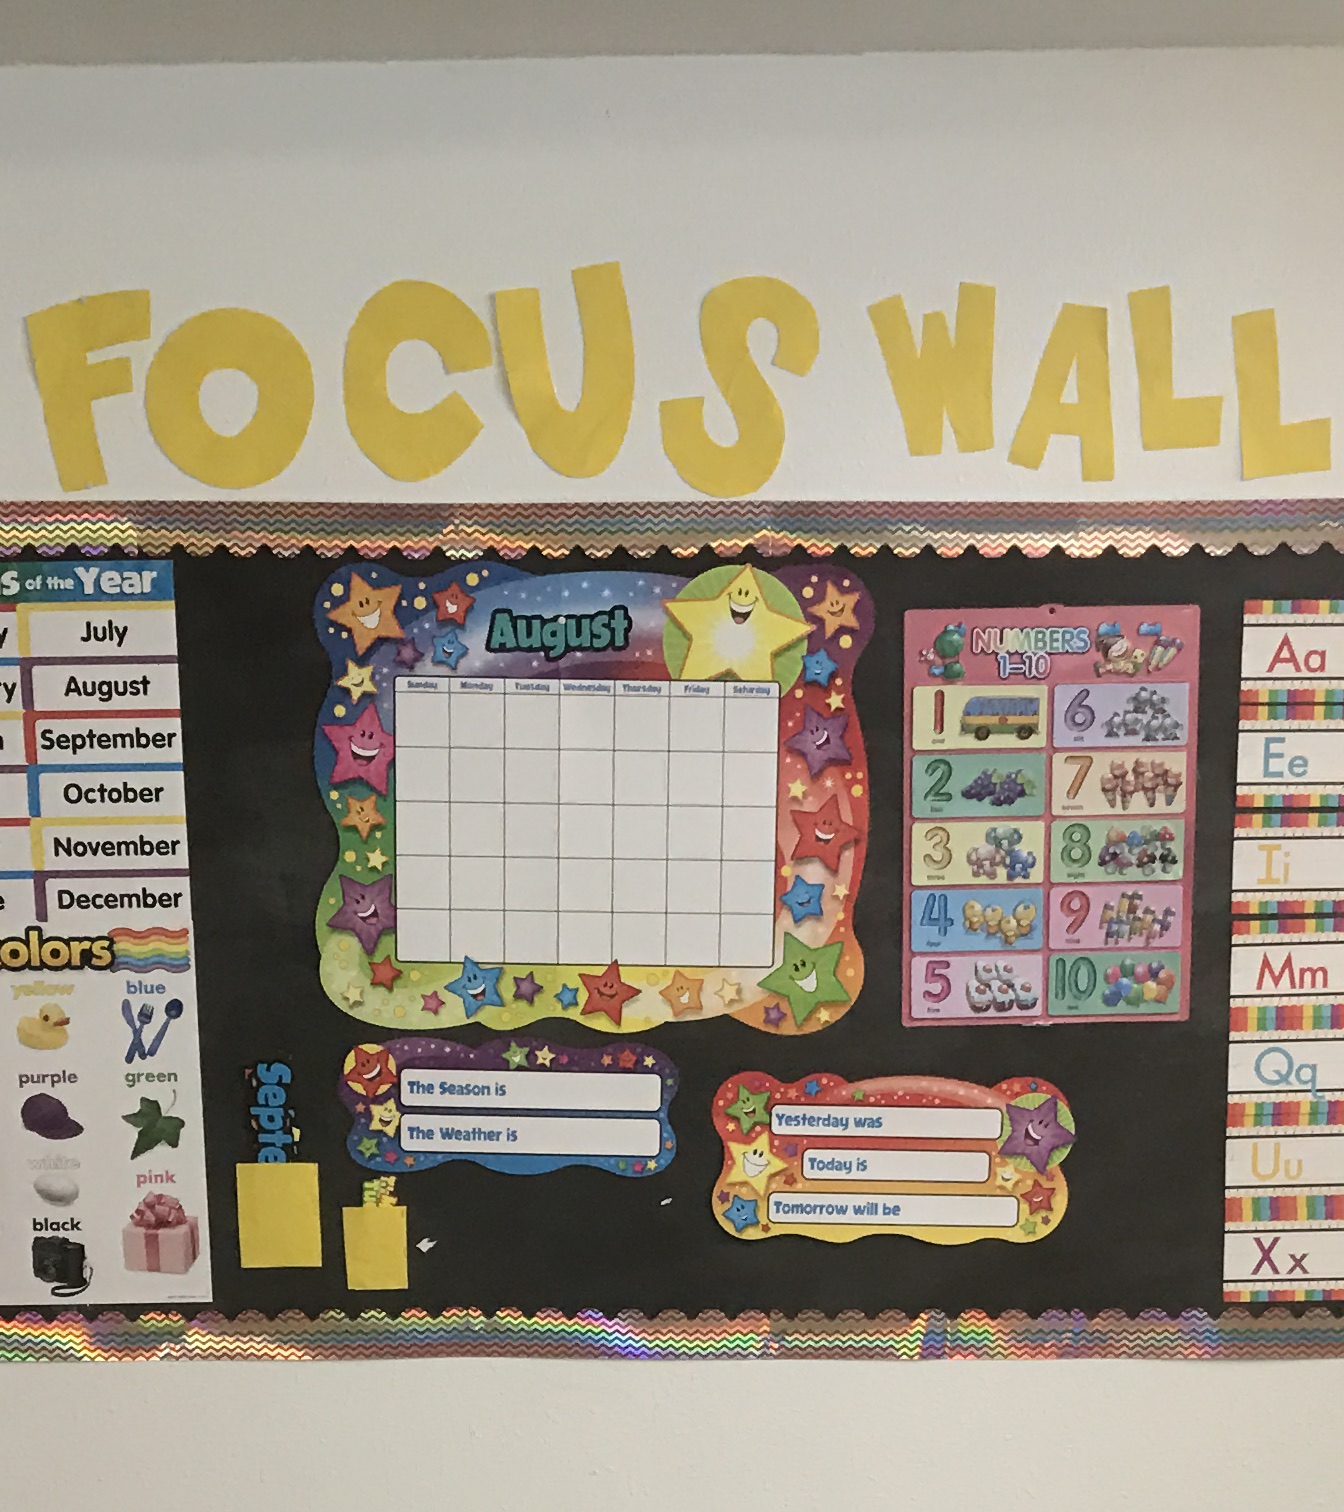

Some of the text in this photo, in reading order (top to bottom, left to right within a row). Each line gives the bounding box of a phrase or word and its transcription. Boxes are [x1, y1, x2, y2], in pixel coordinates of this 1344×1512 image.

[24, 260, 1332, 499] FOCUS WALL
[25, 576, 43, 590] of
[46, 576, 74, 590] the
[74, 566, 157, 594] Year
[80, 621, 128, 646] July
[487, 606, 632, 659] August
[972, 627, 1091, 655] NUMBERS
[997, 653, 1052, 680] 1-10
[1266, 633, 1327, 673] Aa
[64, 676, 150, 702] August
[933, 689, 945, 735] 1
[1064, 688, 1096, 732] 6
[40, 729, 177, 754] September
[1263, 737, 1309, 778] Ee
[924, 759, 953, 802] 2
[1064, 755, 1093, 800] 7
[63, 783, 164, 803] October
[54, 836, 180, 857] November
[923, 826, 952, 871] 3
[1060, 822, 1092, 868] 8
[1256, 843, 1290, 885] Ii
[58, 889, 182, 909] December
[1060, 889, 1090, 935] 9
[920, 893, 954, 937] 4
[923, 960, 951, 1003] 5
[1055, 957, 1097, 1001] 10
[1256, 951, 1328, 990] Mm
[11, 980, 75, 999] yellow
[126, 980, 166, 997] blue
[18, 1069, 78, 1087] purple
[125, 1069, 178, 1087] green
[1254, 1047, 1325, 1099] Qq
[407, 1081, 506, 1096] The Season is
[407, 1126, 518, 1142] The Weather is
[775, 1113, 883, 1131] Yesterday was
[27, 1155, 80, 1171] white
[808, 1157, 867, 1174] Today is
[1251, 1142, 1303, 1181] Uu
[136, 1170, 176, 1188] pink
[774, 1201, 901, 1216] Tomorrow will be
[32, 1217, 82, 1234] black
[1251, 1236, 1310, 1275] Xx
